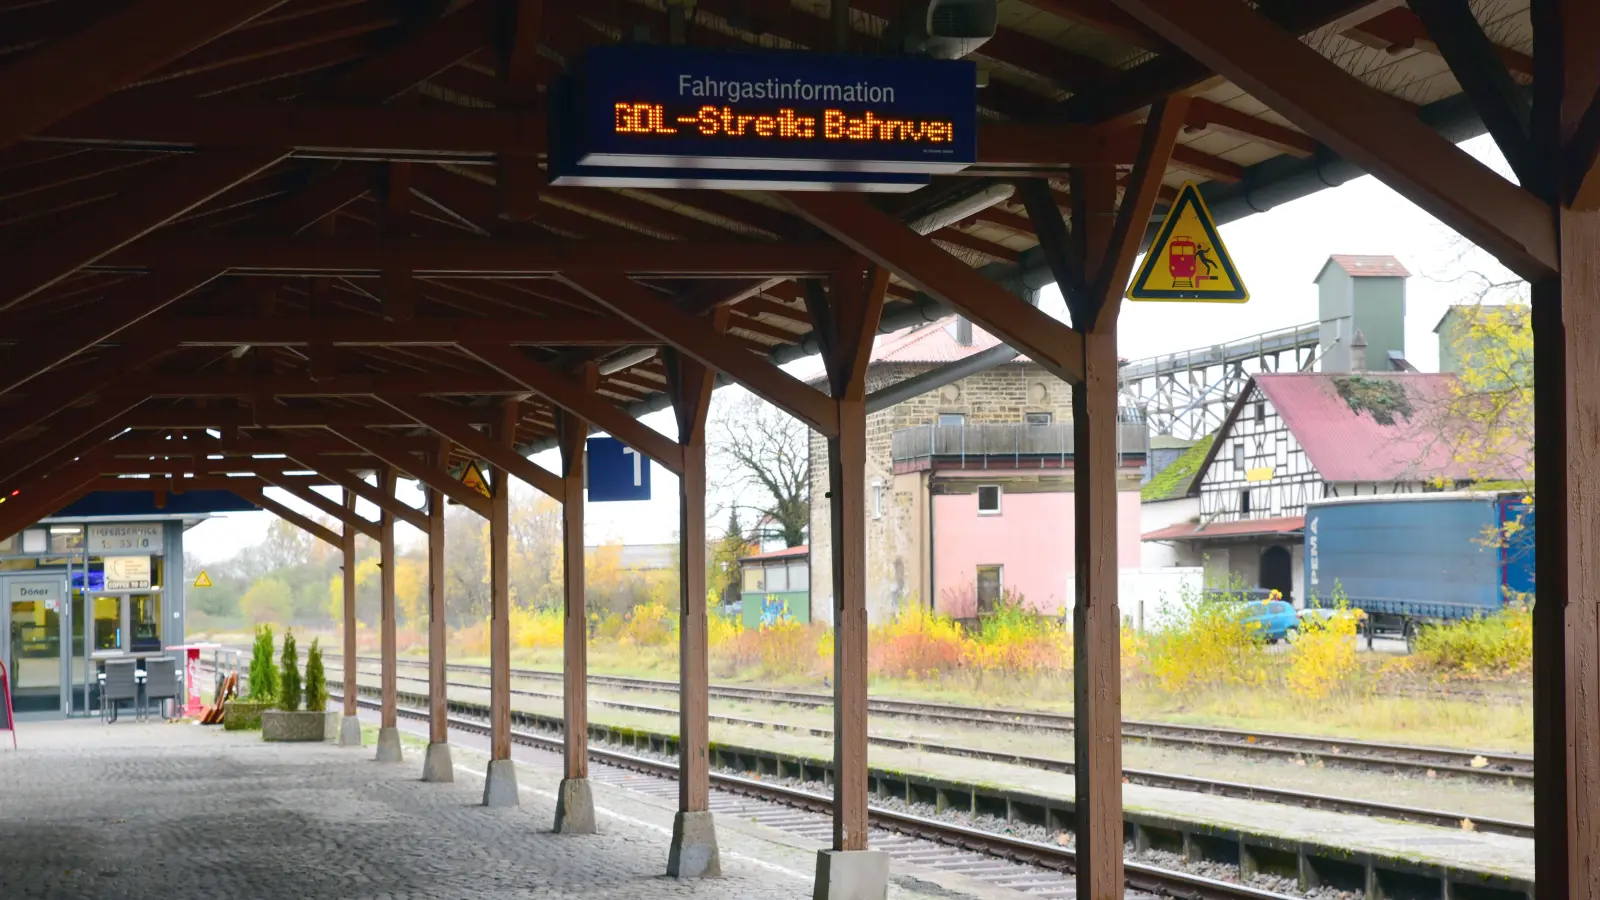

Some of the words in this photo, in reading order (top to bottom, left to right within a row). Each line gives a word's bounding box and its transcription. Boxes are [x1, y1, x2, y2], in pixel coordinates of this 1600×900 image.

[679, 74, 895, 103] Fahrgastinformation
[623, 446, 642, 487] 1
[1310, 516, 1318, 585] PEMA
[20, 587, 48, 596] Döner
